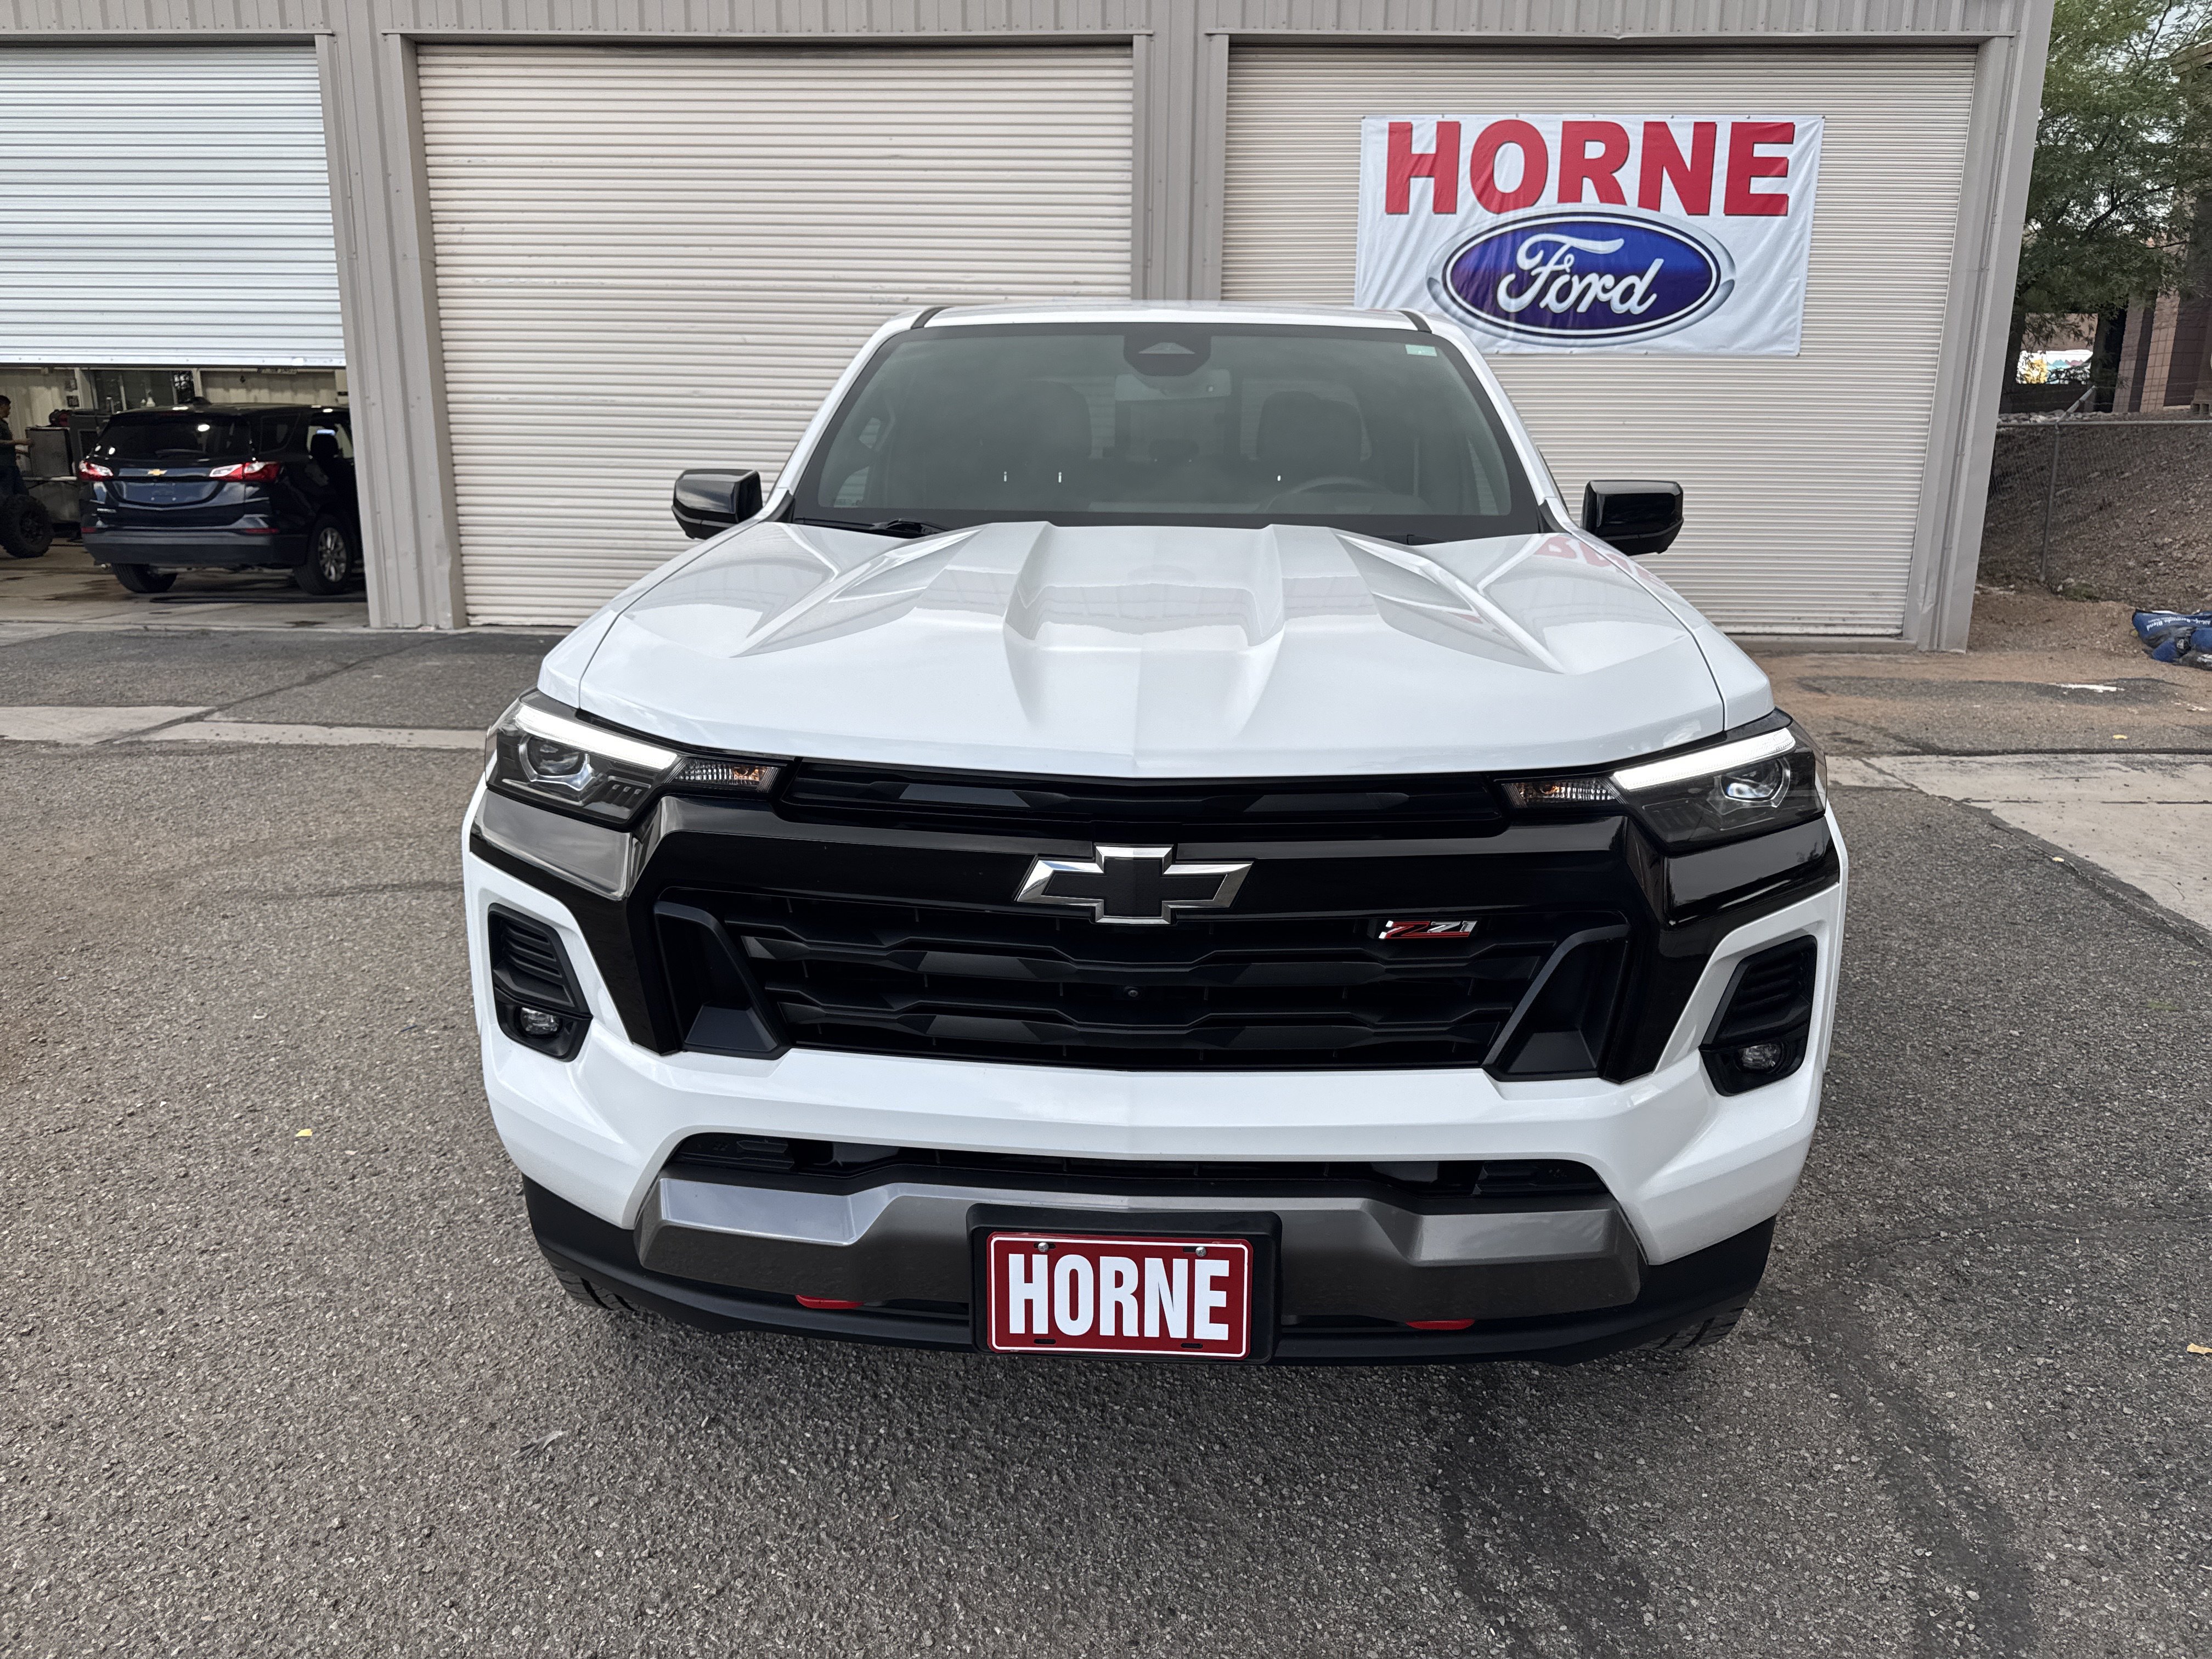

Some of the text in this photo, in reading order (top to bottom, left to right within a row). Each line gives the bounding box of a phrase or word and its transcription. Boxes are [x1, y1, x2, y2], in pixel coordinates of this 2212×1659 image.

[1385, 119, 1795, 217] HORNE
[1497, 233, 1664, 314] Ford
[1379, 920, 1477, 939] Z71
[1008, 1254, 1229, 1340] HORNE
